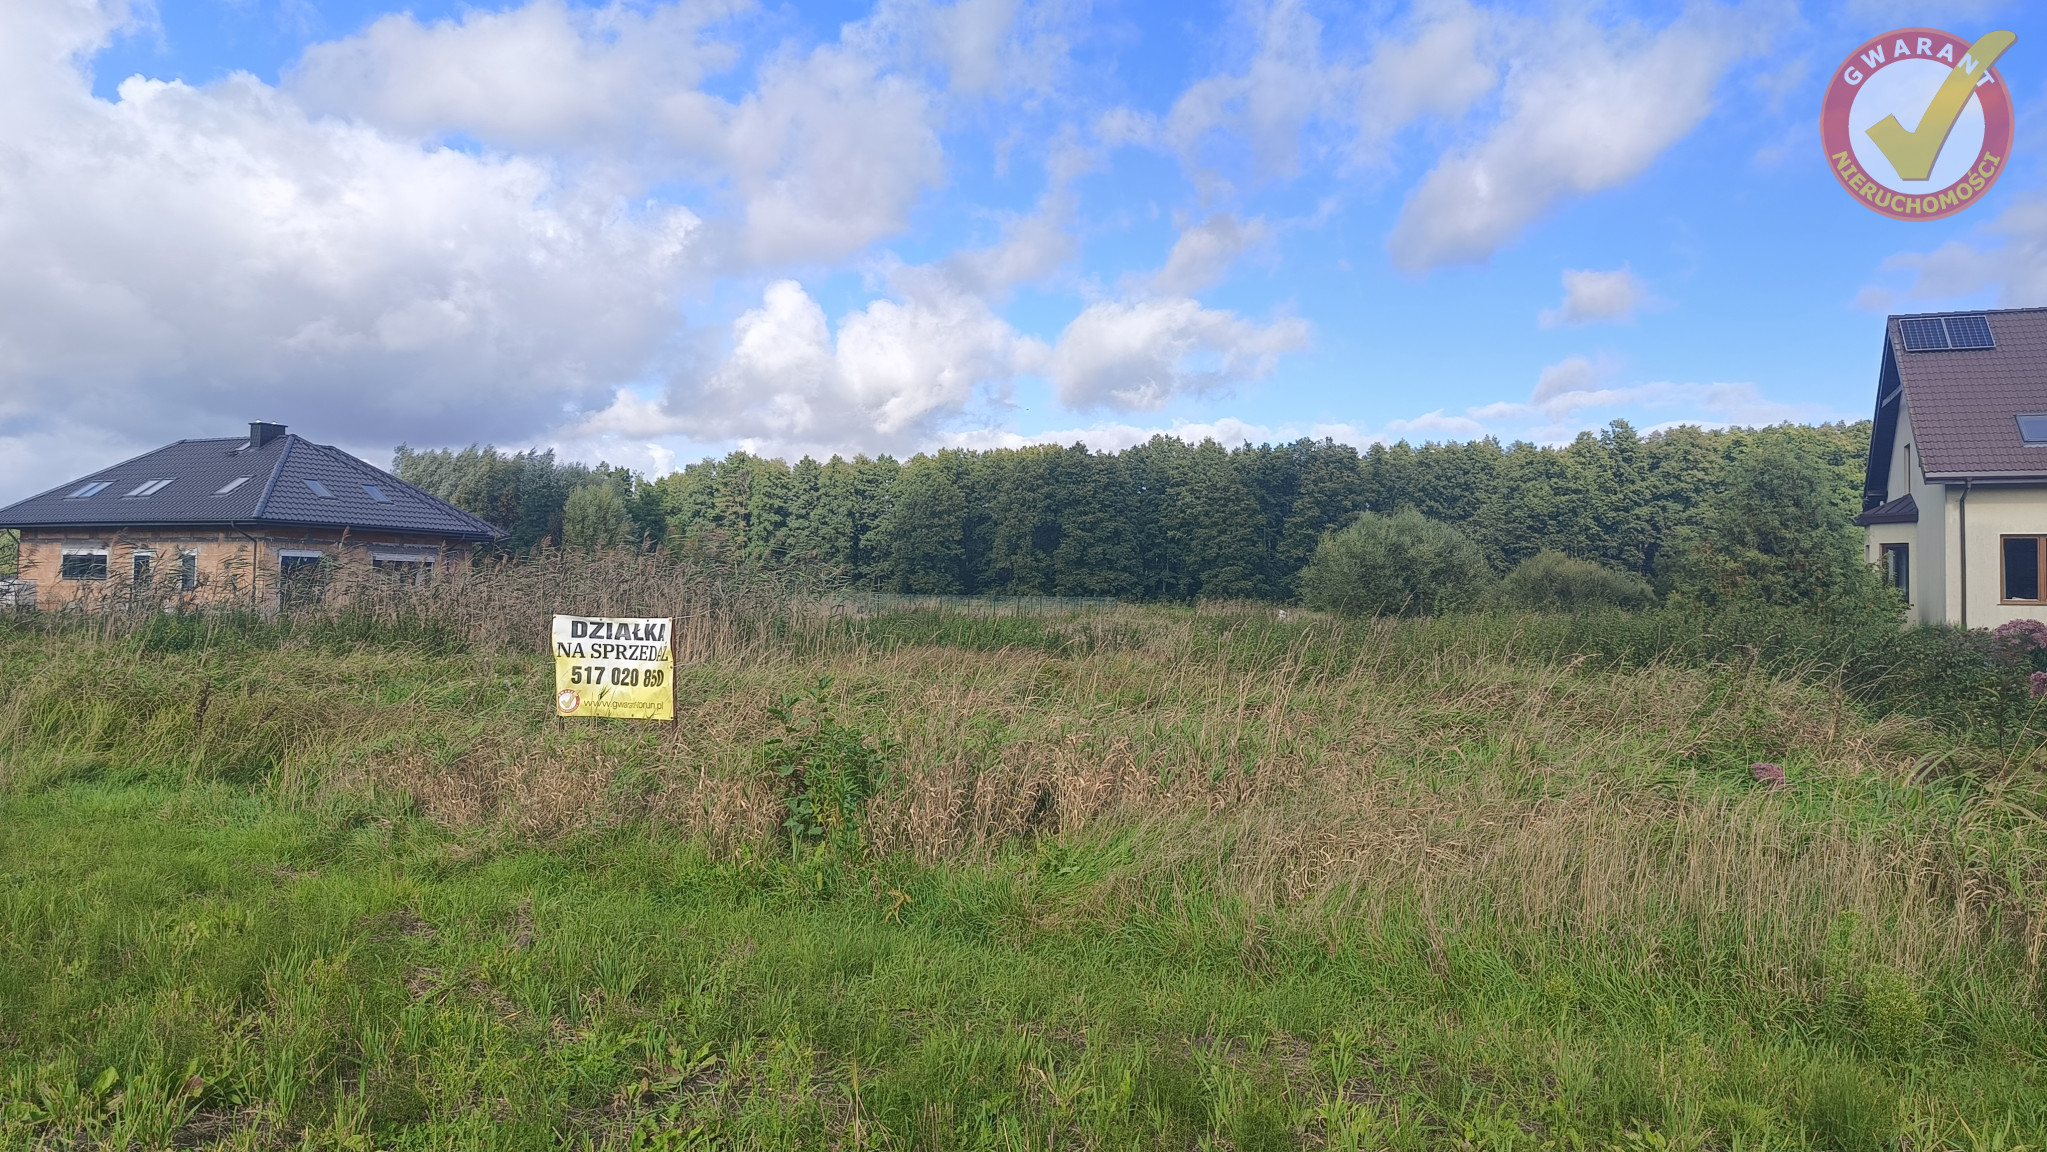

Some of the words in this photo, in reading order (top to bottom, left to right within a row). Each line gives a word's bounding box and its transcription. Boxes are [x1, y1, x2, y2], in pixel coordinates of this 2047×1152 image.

[571, 620, 666, 642] DZIAŁKA
[556, 642, 586, 659] NA
[571, 666, 605, 685] 517
[611, 667, 639, 687] 020
